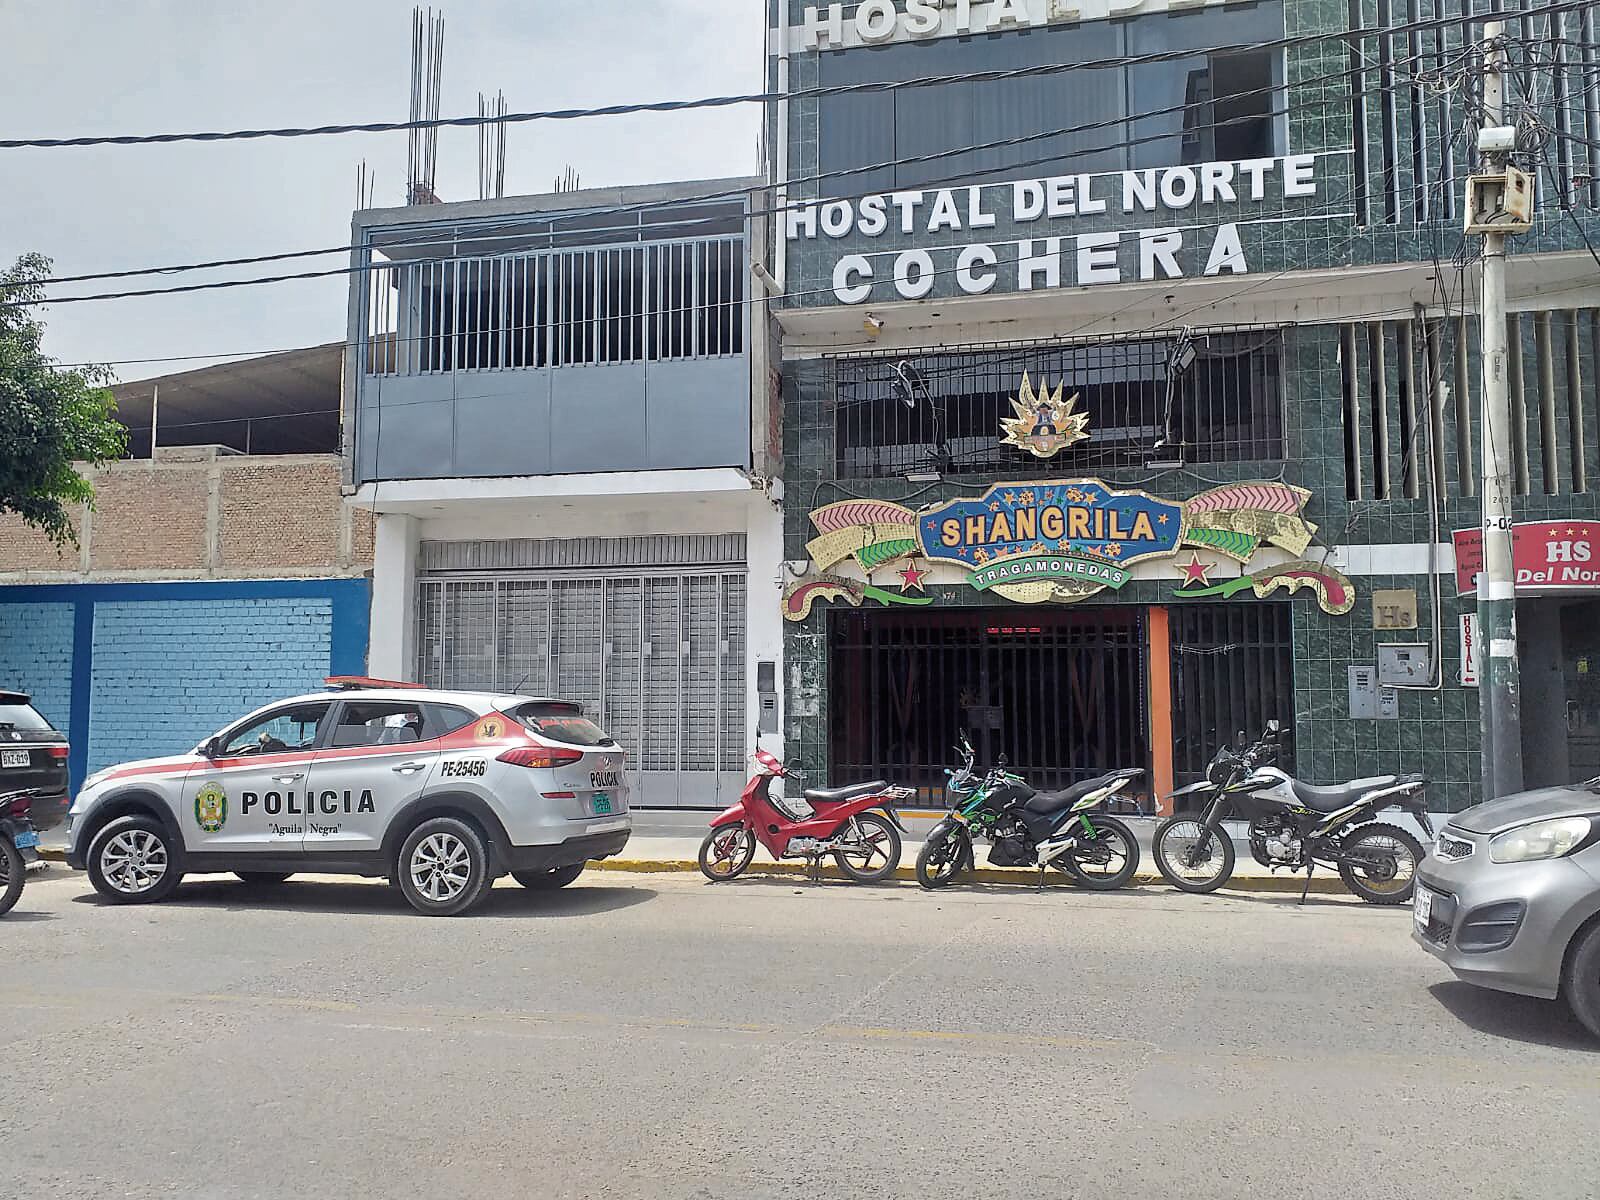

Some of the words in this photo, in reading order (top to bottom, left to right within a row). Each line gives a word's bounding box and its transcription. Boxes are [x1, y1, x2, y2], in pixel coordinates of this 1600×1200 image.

[786, 186, 995, 240] HOSTAL
[1013, 173, 1106, 223] DEL
[1122, 154, 1317, 212] NORTE
[832, 222, 1249, 305] COCHERA
[941, 505, 1156, 547] SHANGRILA
[1546, 540, 1591, 562] HS
[975, 560, 1123, 585] TRAGAMONEDAS
[1517, 566, 1554, 583] Del
[1562, 566, 1600, 582] Nor
[1377, 605, 1411, 628] Hs
[1464, 616, 1474, 673] HOSTAL
[441, 760, 486, 777] PE-25456
[591, 771, 619, 788] POLICIA
[241, 789, 376, 815] POLICIA
